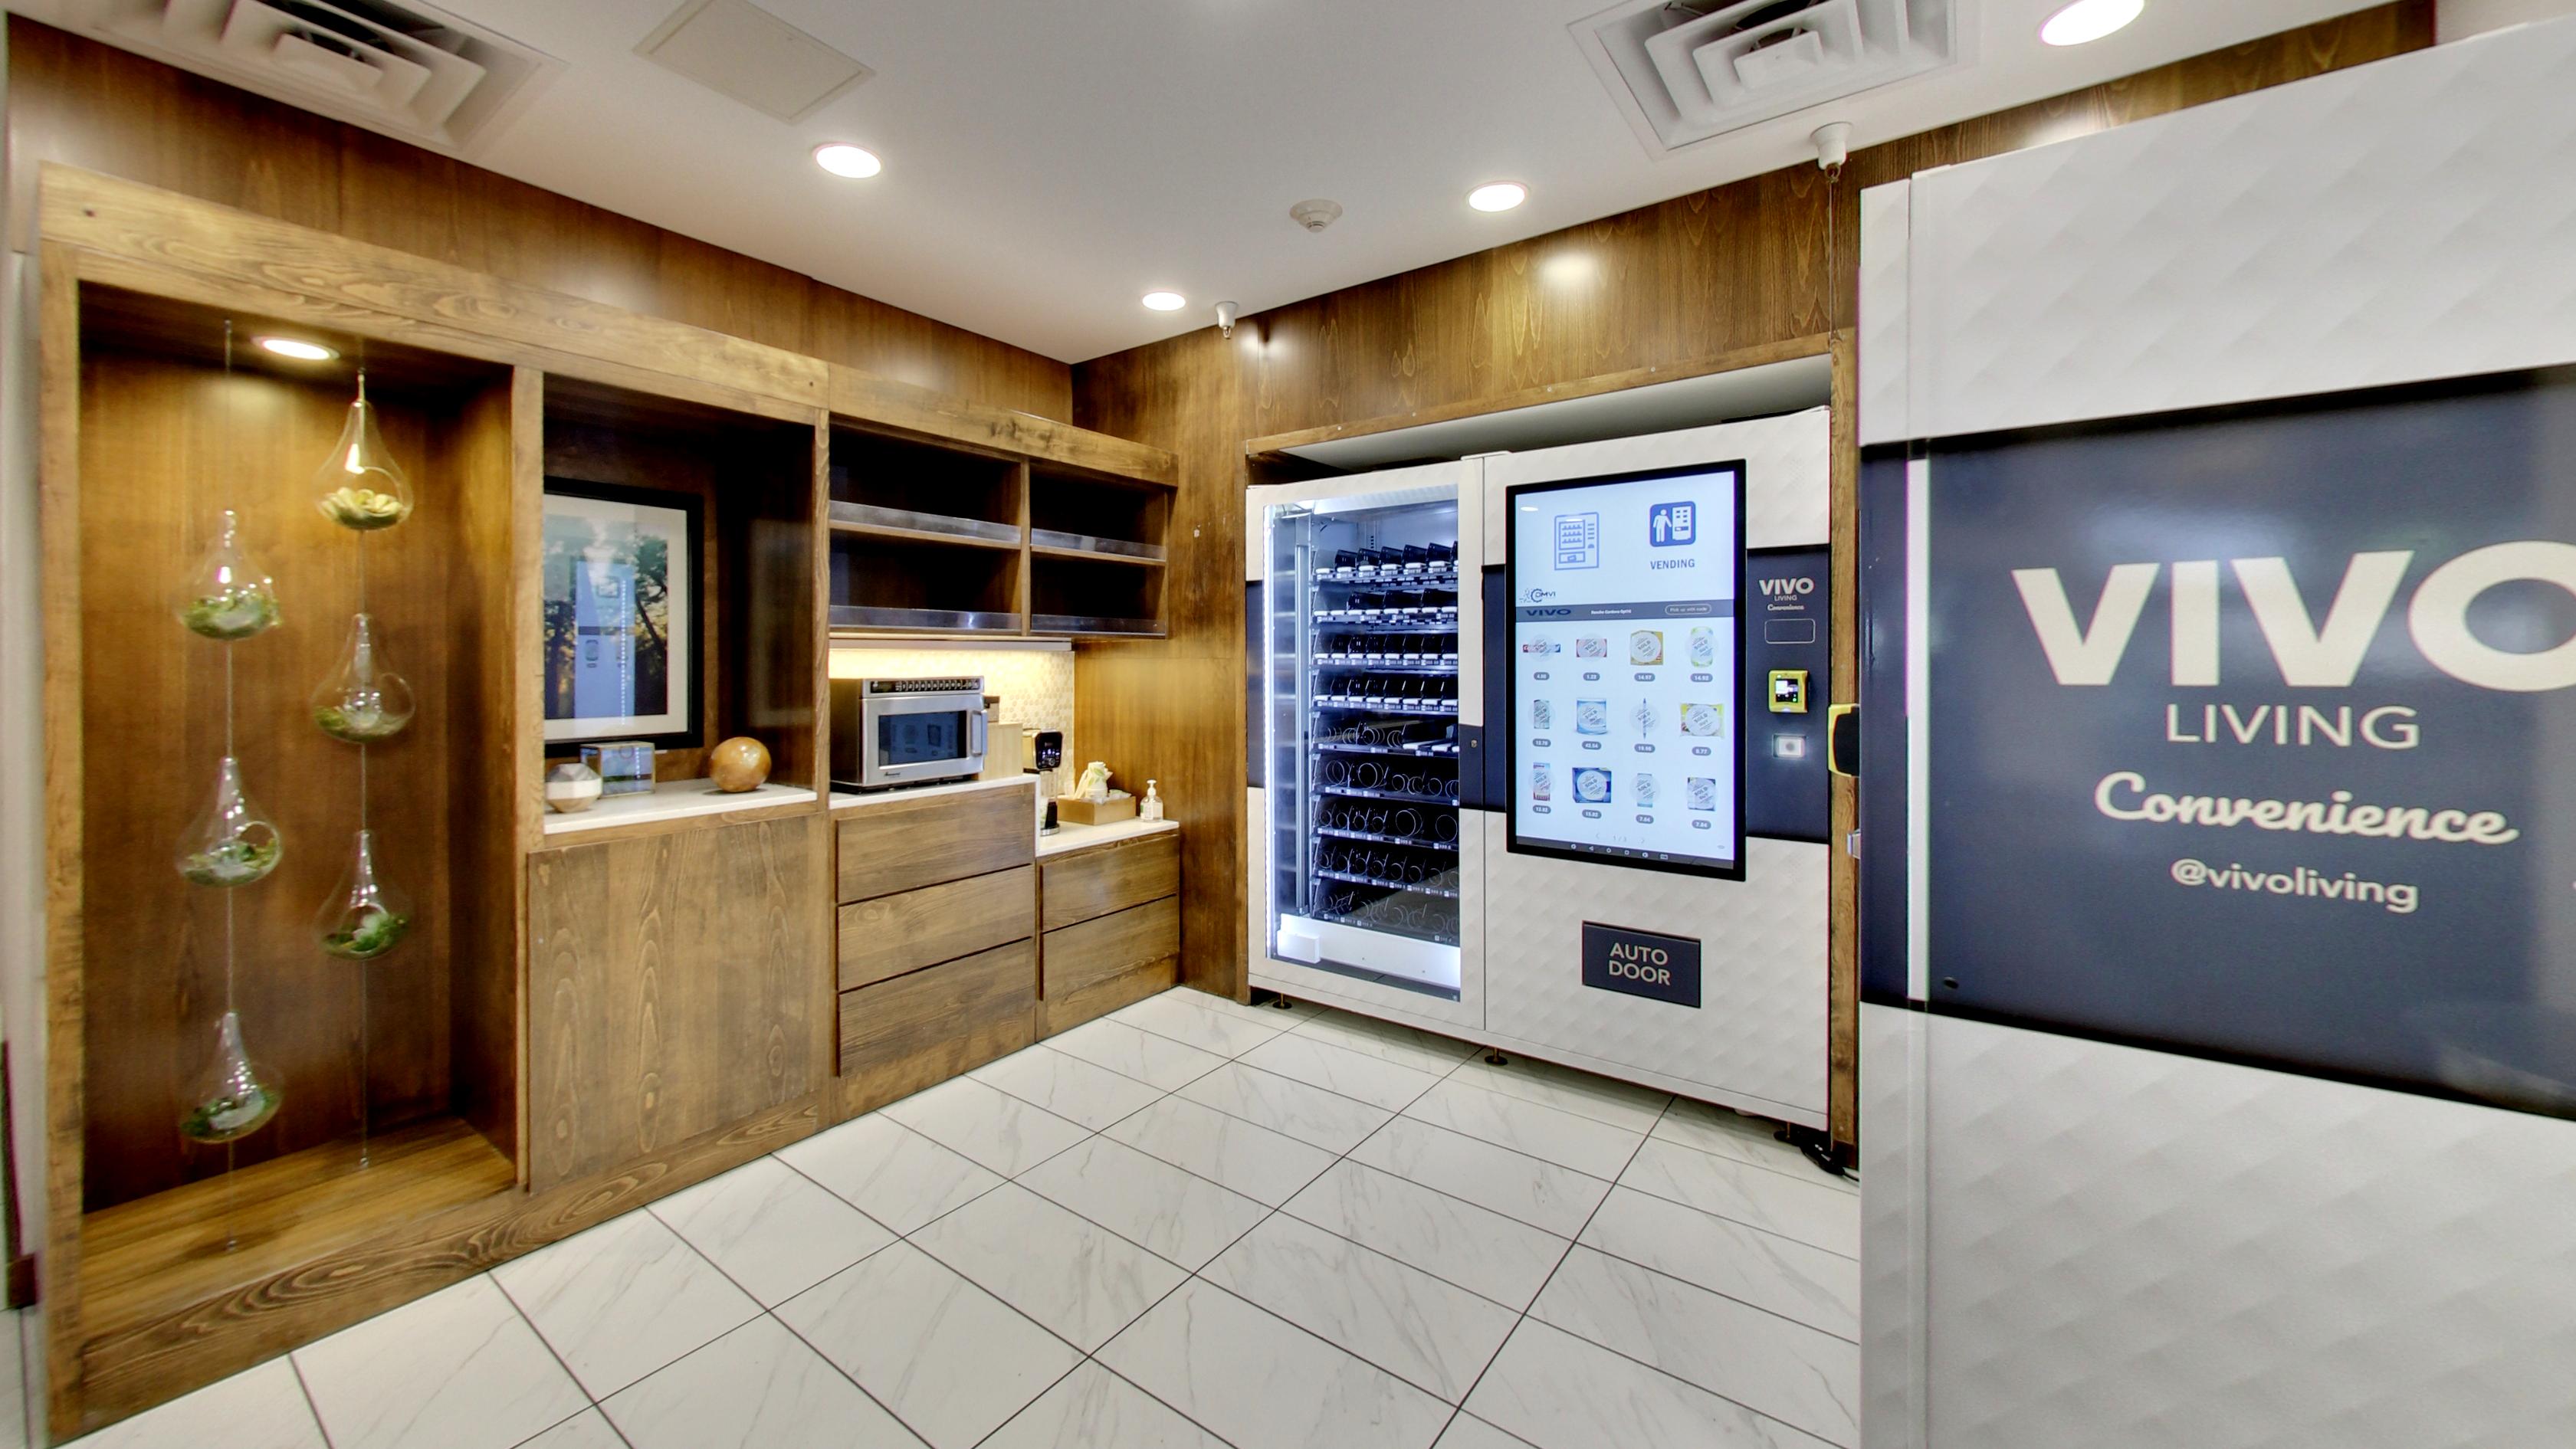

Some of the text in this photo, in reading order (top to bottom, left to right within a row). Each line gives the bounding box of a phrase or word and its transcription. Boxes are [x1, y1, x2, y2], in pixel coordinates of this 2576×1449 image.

[1650, 559, 1695, 570] VENDING
[1759, 577, 1814, 595] VIVO
[2011, 539, 2576, 692] VIVO
[2166, 703, 2420, 749] LIVING
[2094, 770, 2519, 845] Convenience
[2171, 858, 2419, 913] @vivoliving
[1609, 959, 1671, 985] DOOR
[1610, 943, 1668, 965] AUTO
